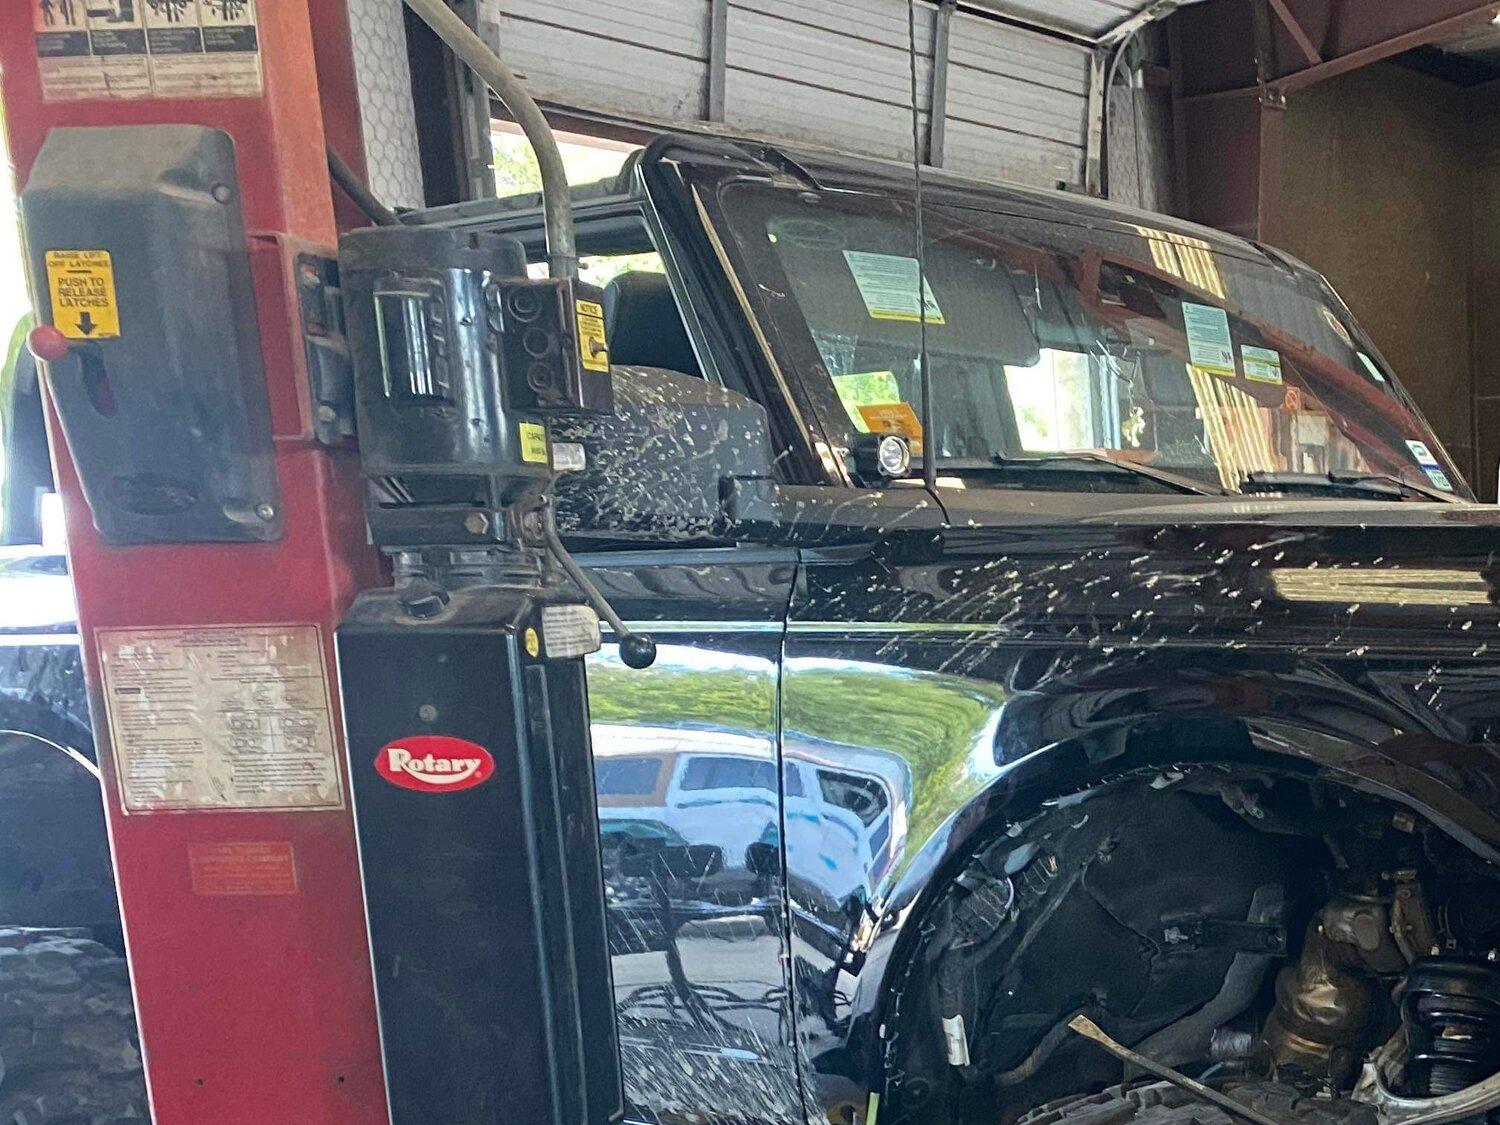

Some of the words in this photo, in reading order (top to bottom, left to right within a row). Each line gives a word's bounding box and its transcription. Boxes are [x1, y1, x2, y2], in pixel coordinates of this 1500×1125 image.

[57, 278, 87, 287] PUSH
[91, 278, 104, 286] TO
[59, 287, 107, 297] RELEASE
[60, 297, 109, 307] LATCHES
[387, 747, 482, 783] Rotary
